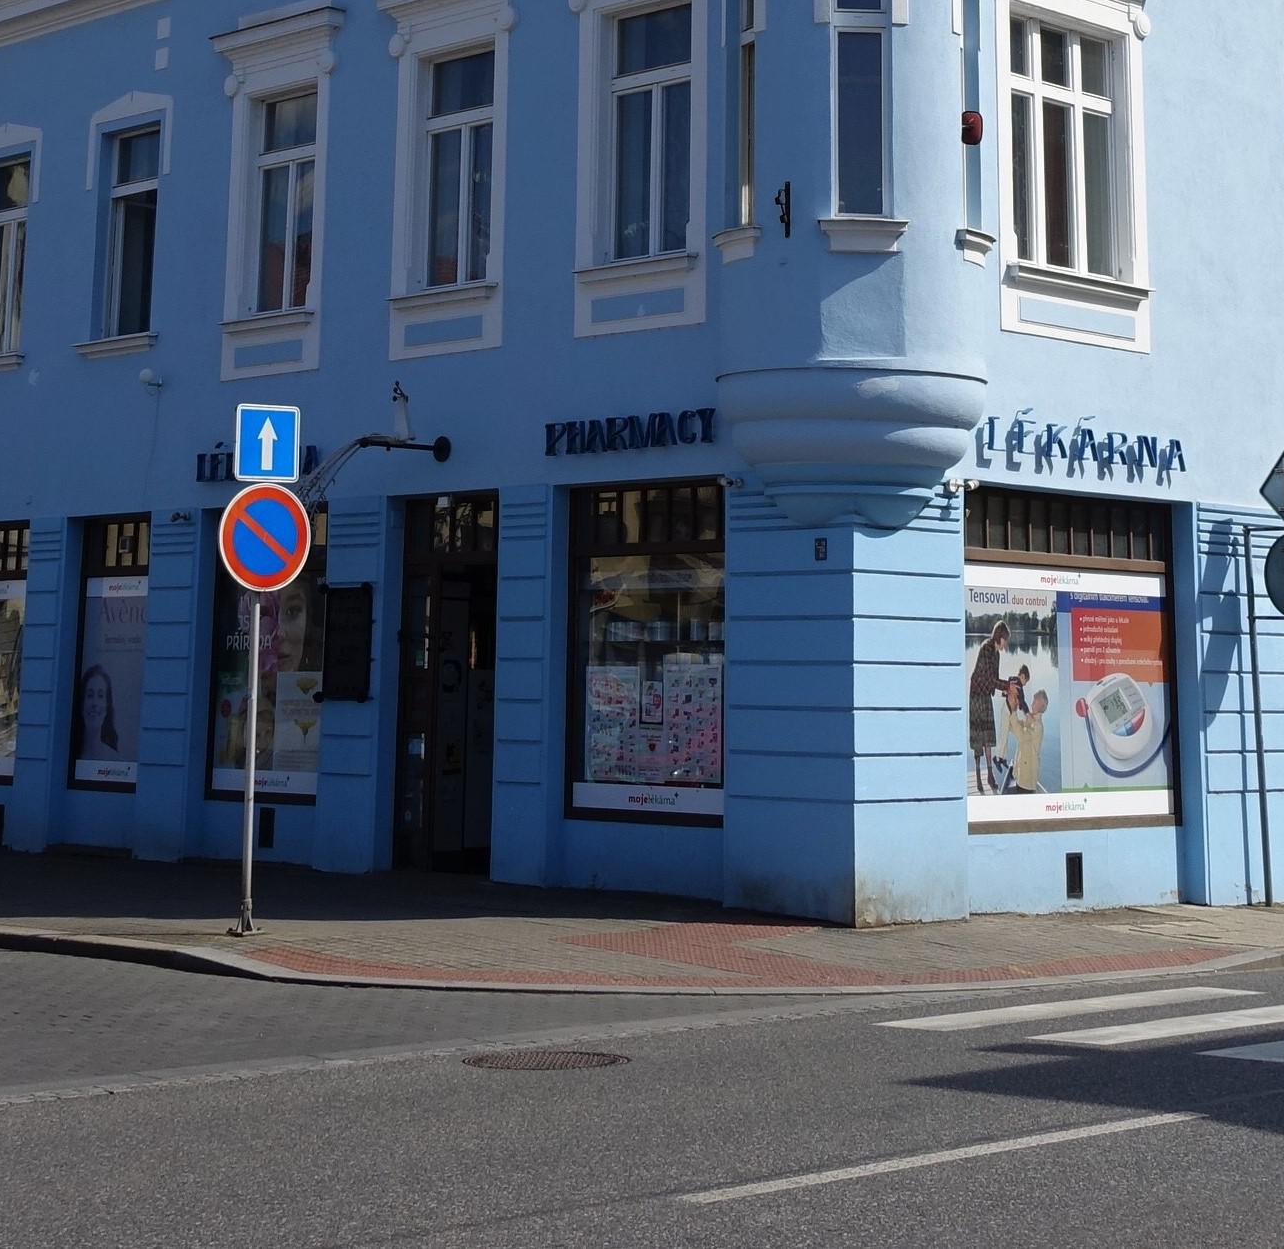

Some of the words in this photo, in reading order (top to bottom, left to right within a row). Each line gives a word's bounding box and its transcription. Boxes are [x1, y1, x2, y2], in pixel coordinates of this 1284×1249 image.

[545, 408, 716, 456] PHARMACY
[987, 408, 1186, 472] LÉKÁRNA
[969, 589, 1009, 604] Tensoval
[1012, 597, 1024, 605] duo
[1025, 597, 1048, 607] control
[226, 631, 271, 650] PŘÍRDA
